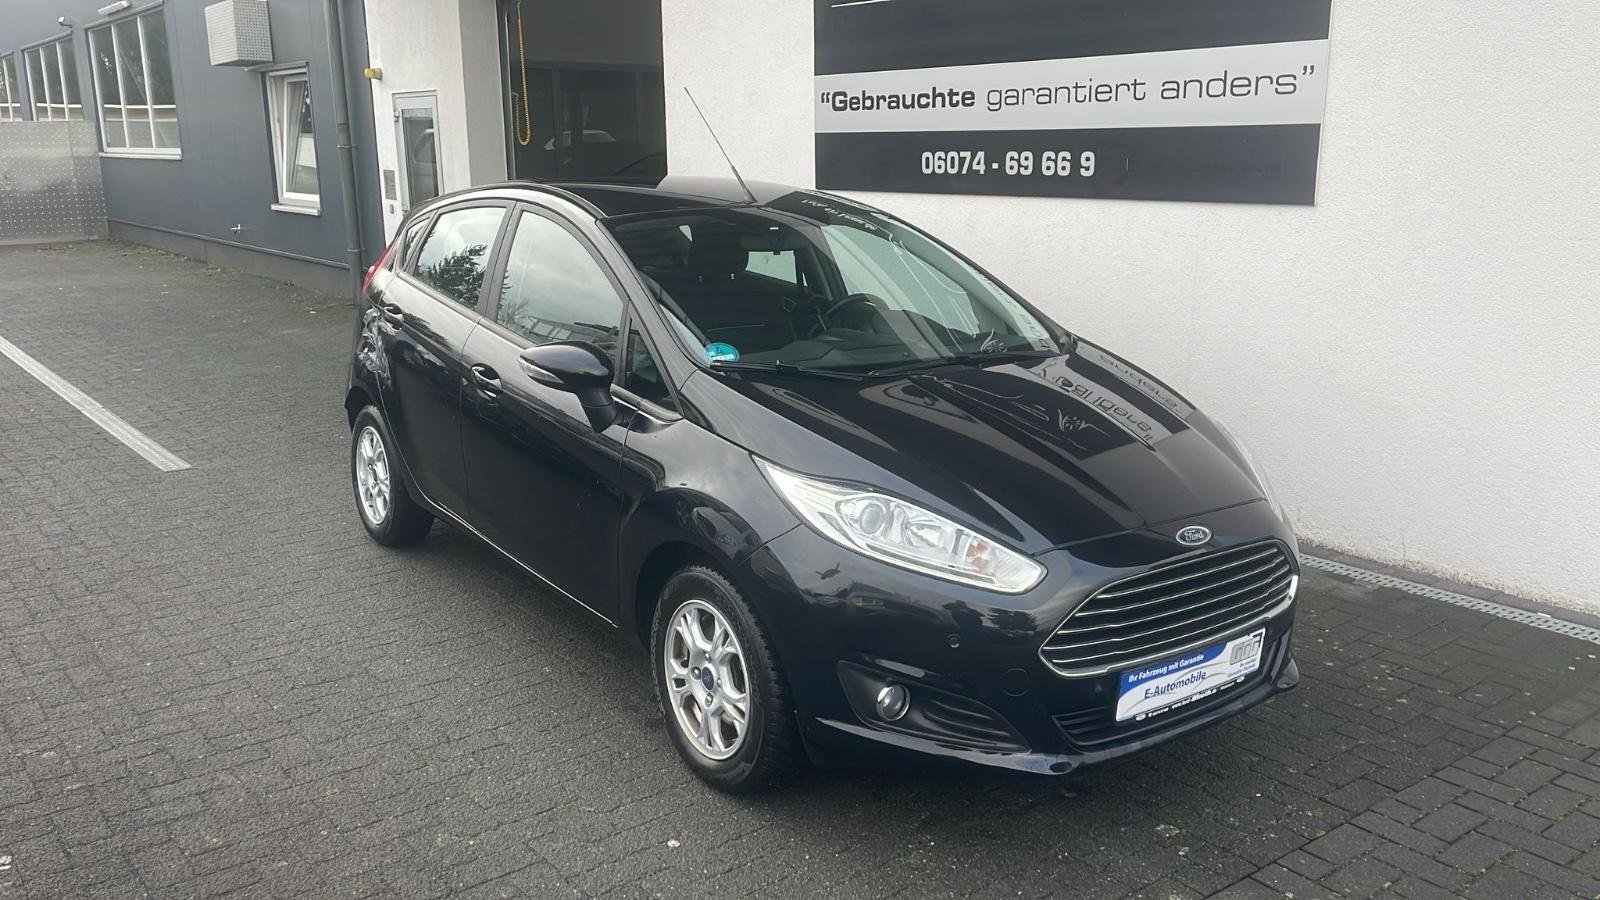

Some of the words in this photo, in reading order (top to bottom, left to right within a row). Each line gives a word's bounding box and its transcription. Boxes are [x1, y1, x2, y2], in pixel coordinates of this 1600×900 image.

[986, 77, 1146, 112] garantiert
[921, 150, 986, 175] 06074
[1005, 150, 1034, 176] 69
[1041, 150, 1072, 177] 66
[1079, 151, 1096, 177] 9
[1184, 529, 1205, 543] Ford
[1128, 674, 1139, 683] Ihr
[1138, 666, 1168, 680] Fahrzeug
[1168, 661, 1179, 671] mit
[1179, 653, 1205, 667] Garantie
[1144, 670, 1207, 699] E-Automobile
